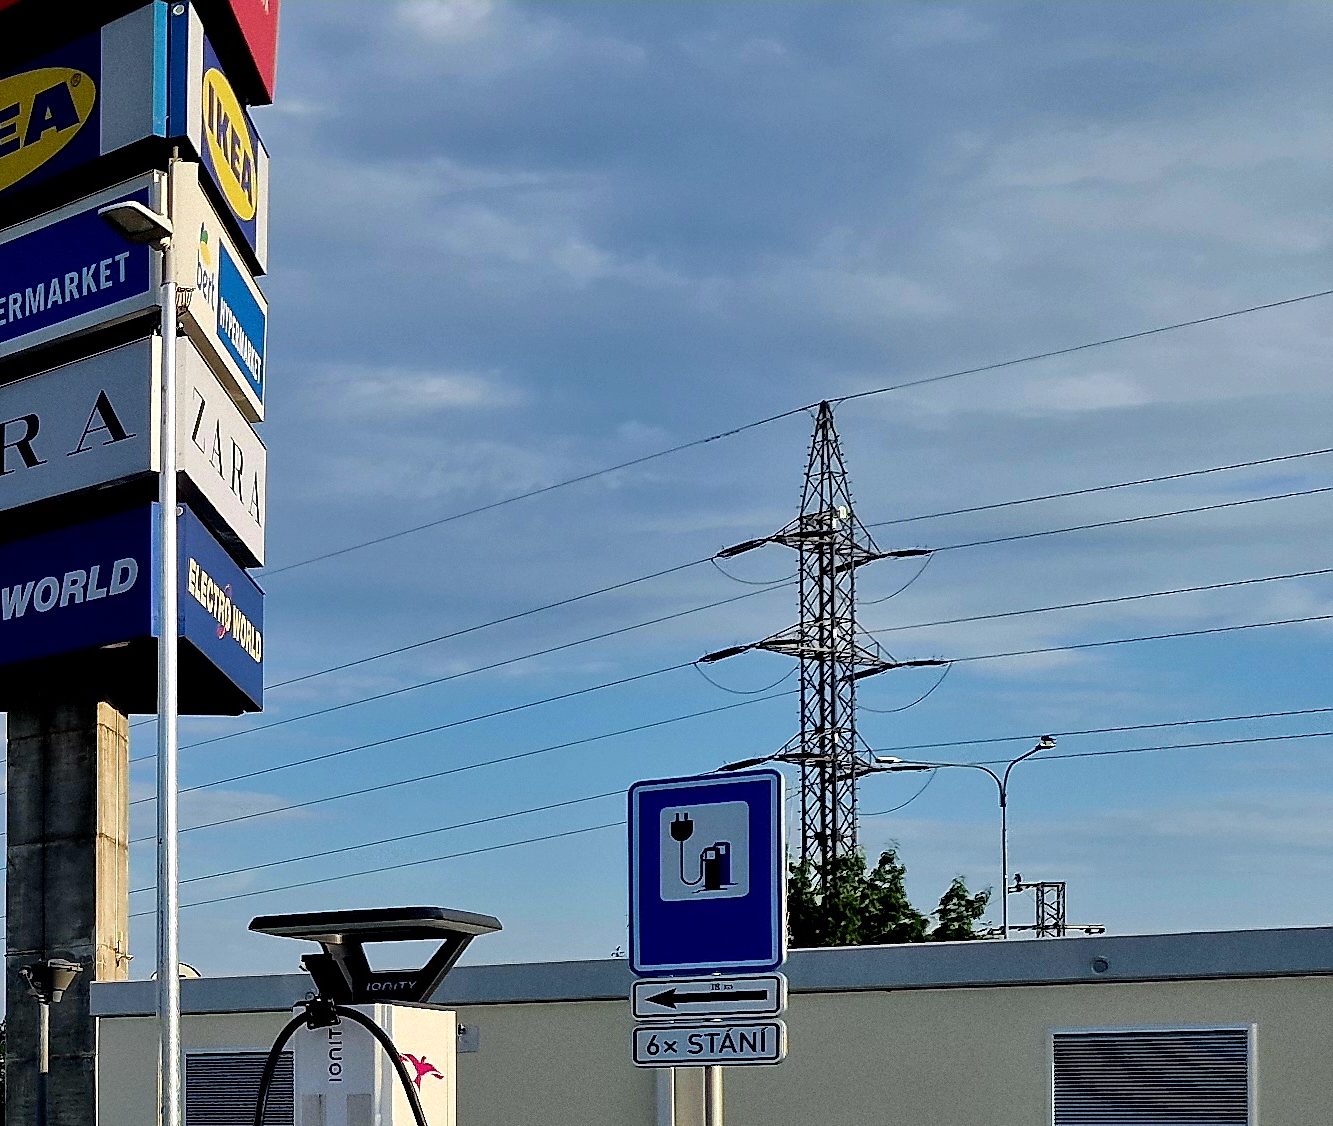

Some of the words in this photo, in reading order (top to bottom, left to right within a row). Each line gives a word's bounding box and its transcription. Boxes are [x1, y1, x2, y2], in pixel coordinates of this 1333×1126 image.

[208, 80, 254, 209] IKEA
[219, 296, 263, 384] HYPERMARKET
[193, 386, 262, 528] ZARA
[1, 557, 139, 621] WORLD
[188, 557, 232, 633] ELECTRO
[232, 604, 263, 664] WORLD
[366, 980, 417, 991] IONITY
[328, 1027, 343, 1082] IONIT
[686, 1026, 769, 1055] STÁNÍ
